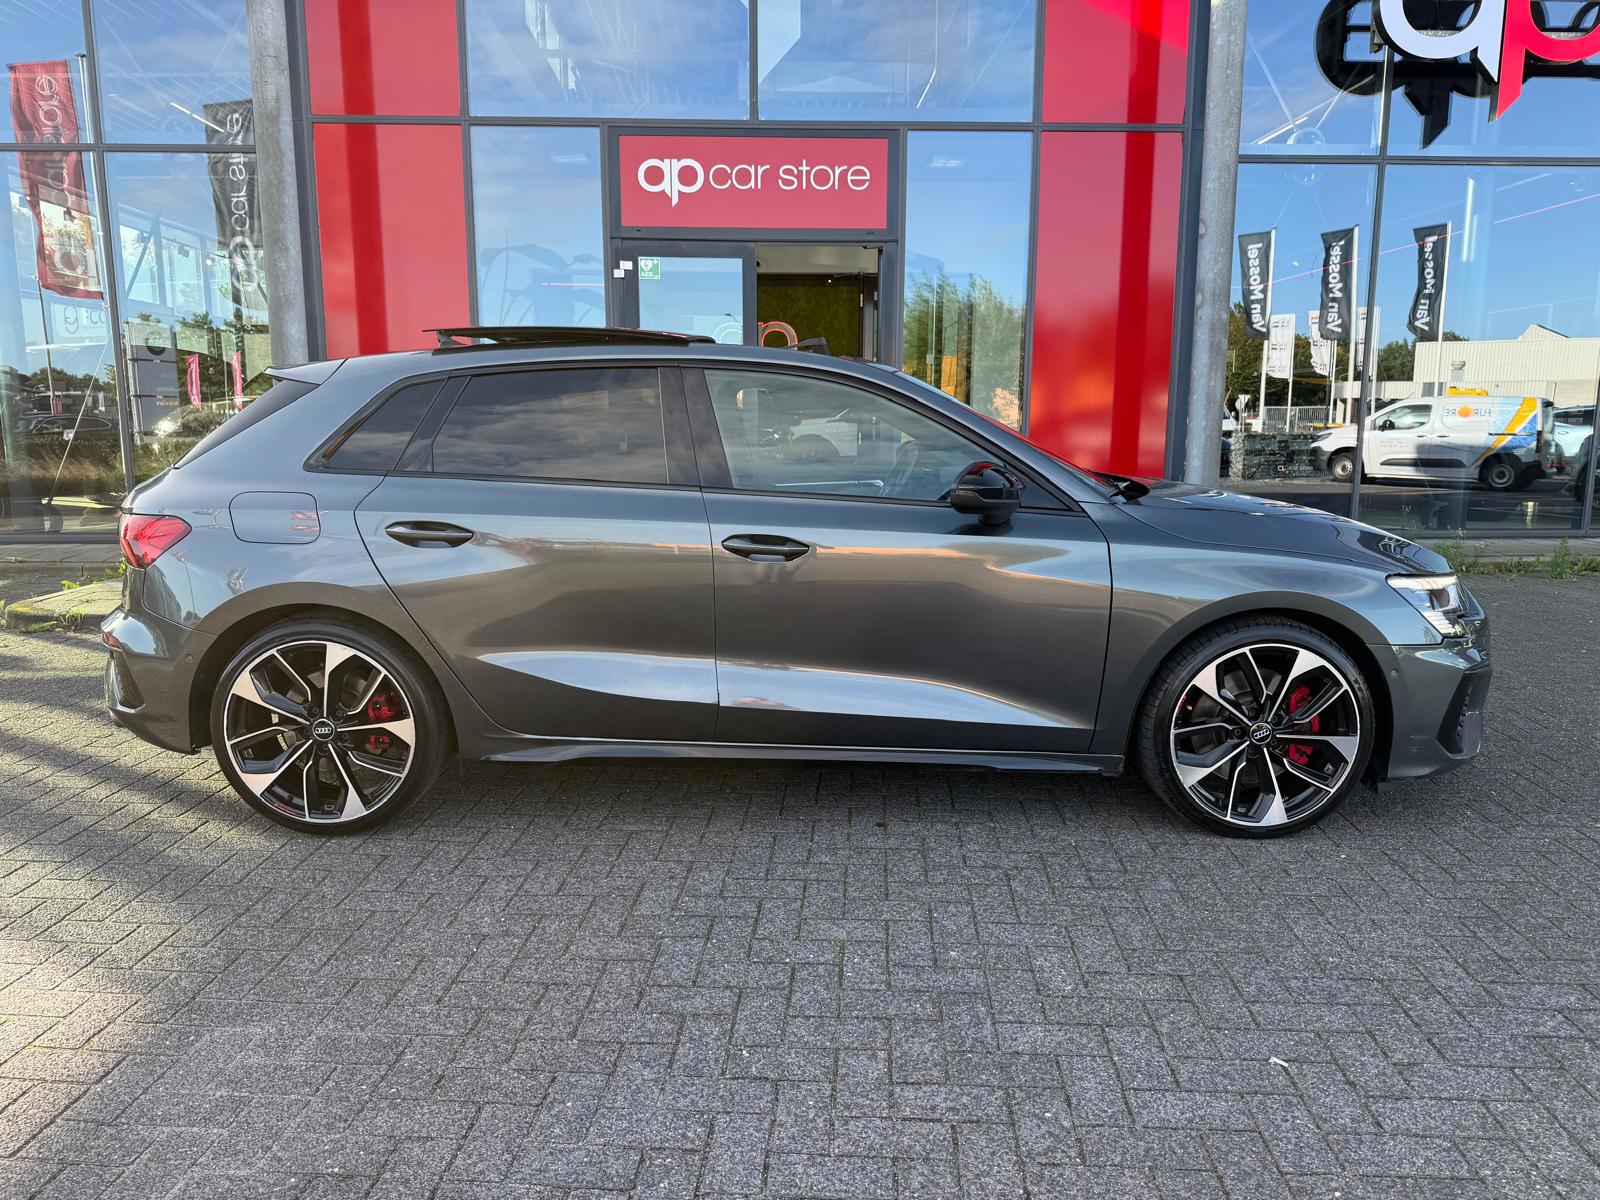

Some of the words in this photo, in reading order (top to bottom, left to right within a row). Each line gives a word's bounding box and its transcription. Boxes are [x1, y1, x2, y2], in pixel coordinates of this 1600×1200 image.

[637, 158, 705, 208] ap
[709, 164, 770, 189] car
[778, 159, 871, 190] store
